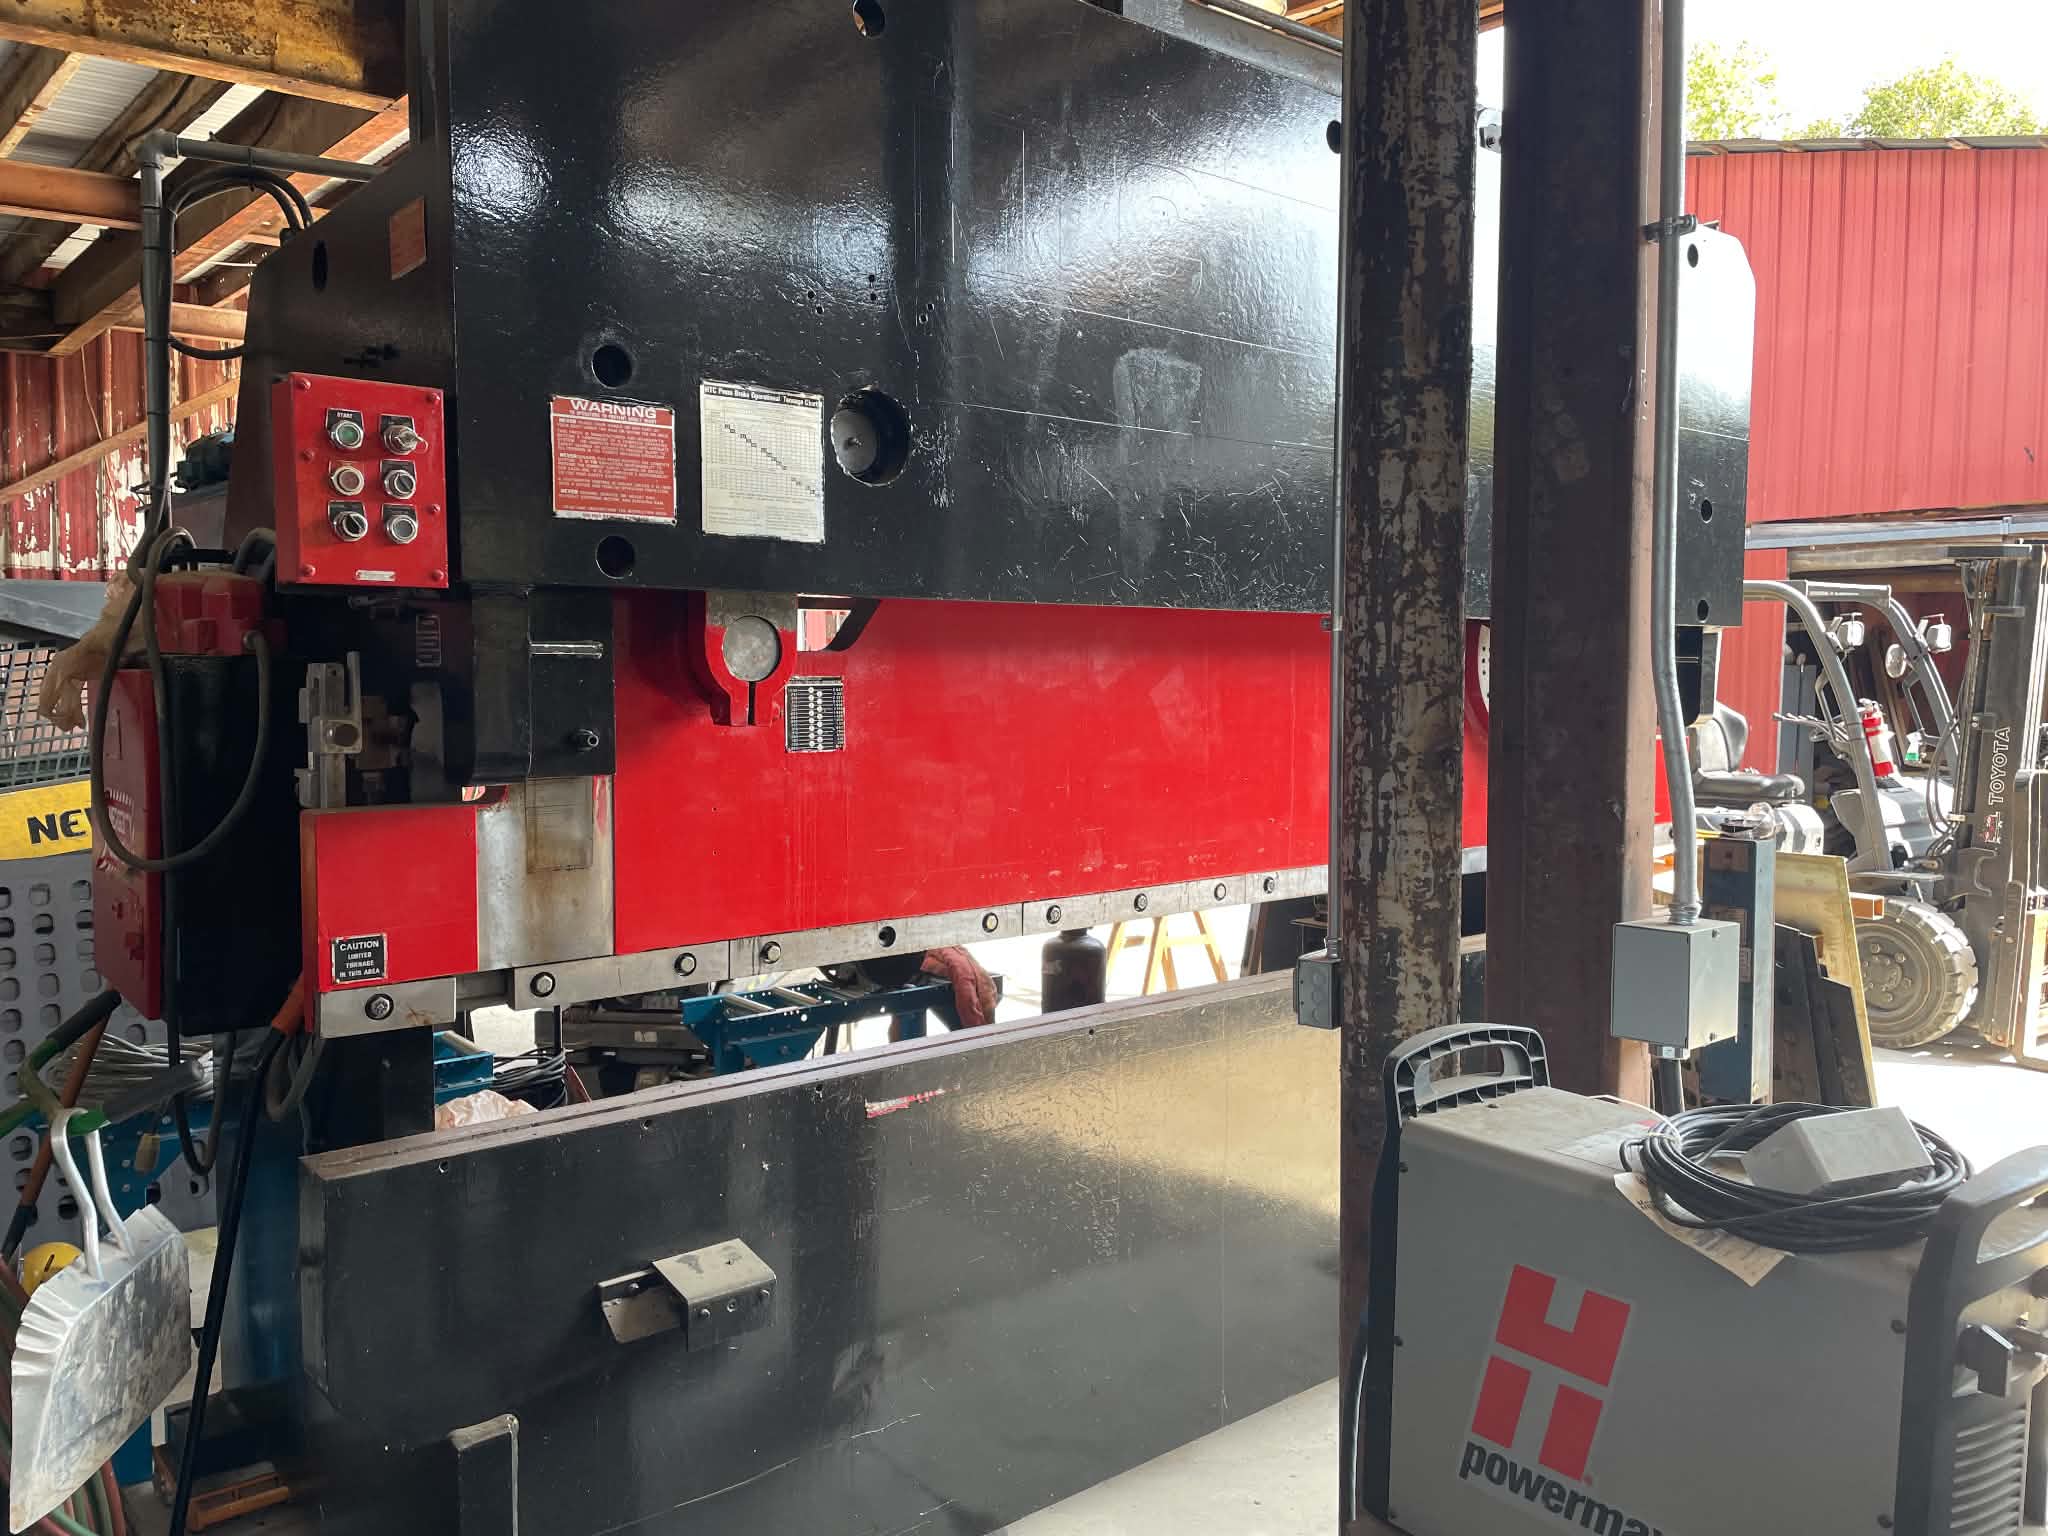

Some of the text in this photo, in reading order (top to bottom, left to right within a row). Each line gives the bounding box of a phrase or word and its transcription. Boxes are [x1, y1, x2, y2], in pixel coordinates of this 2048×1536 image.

[569, 399, 656, 419] WARNING
[1988, 726, 2011, 806] TOYOTA
[340, 940, 379, 951] CAUTION
[348, 952, 372, 960] LIMITED
[364, 968, 380, 976] AREA
